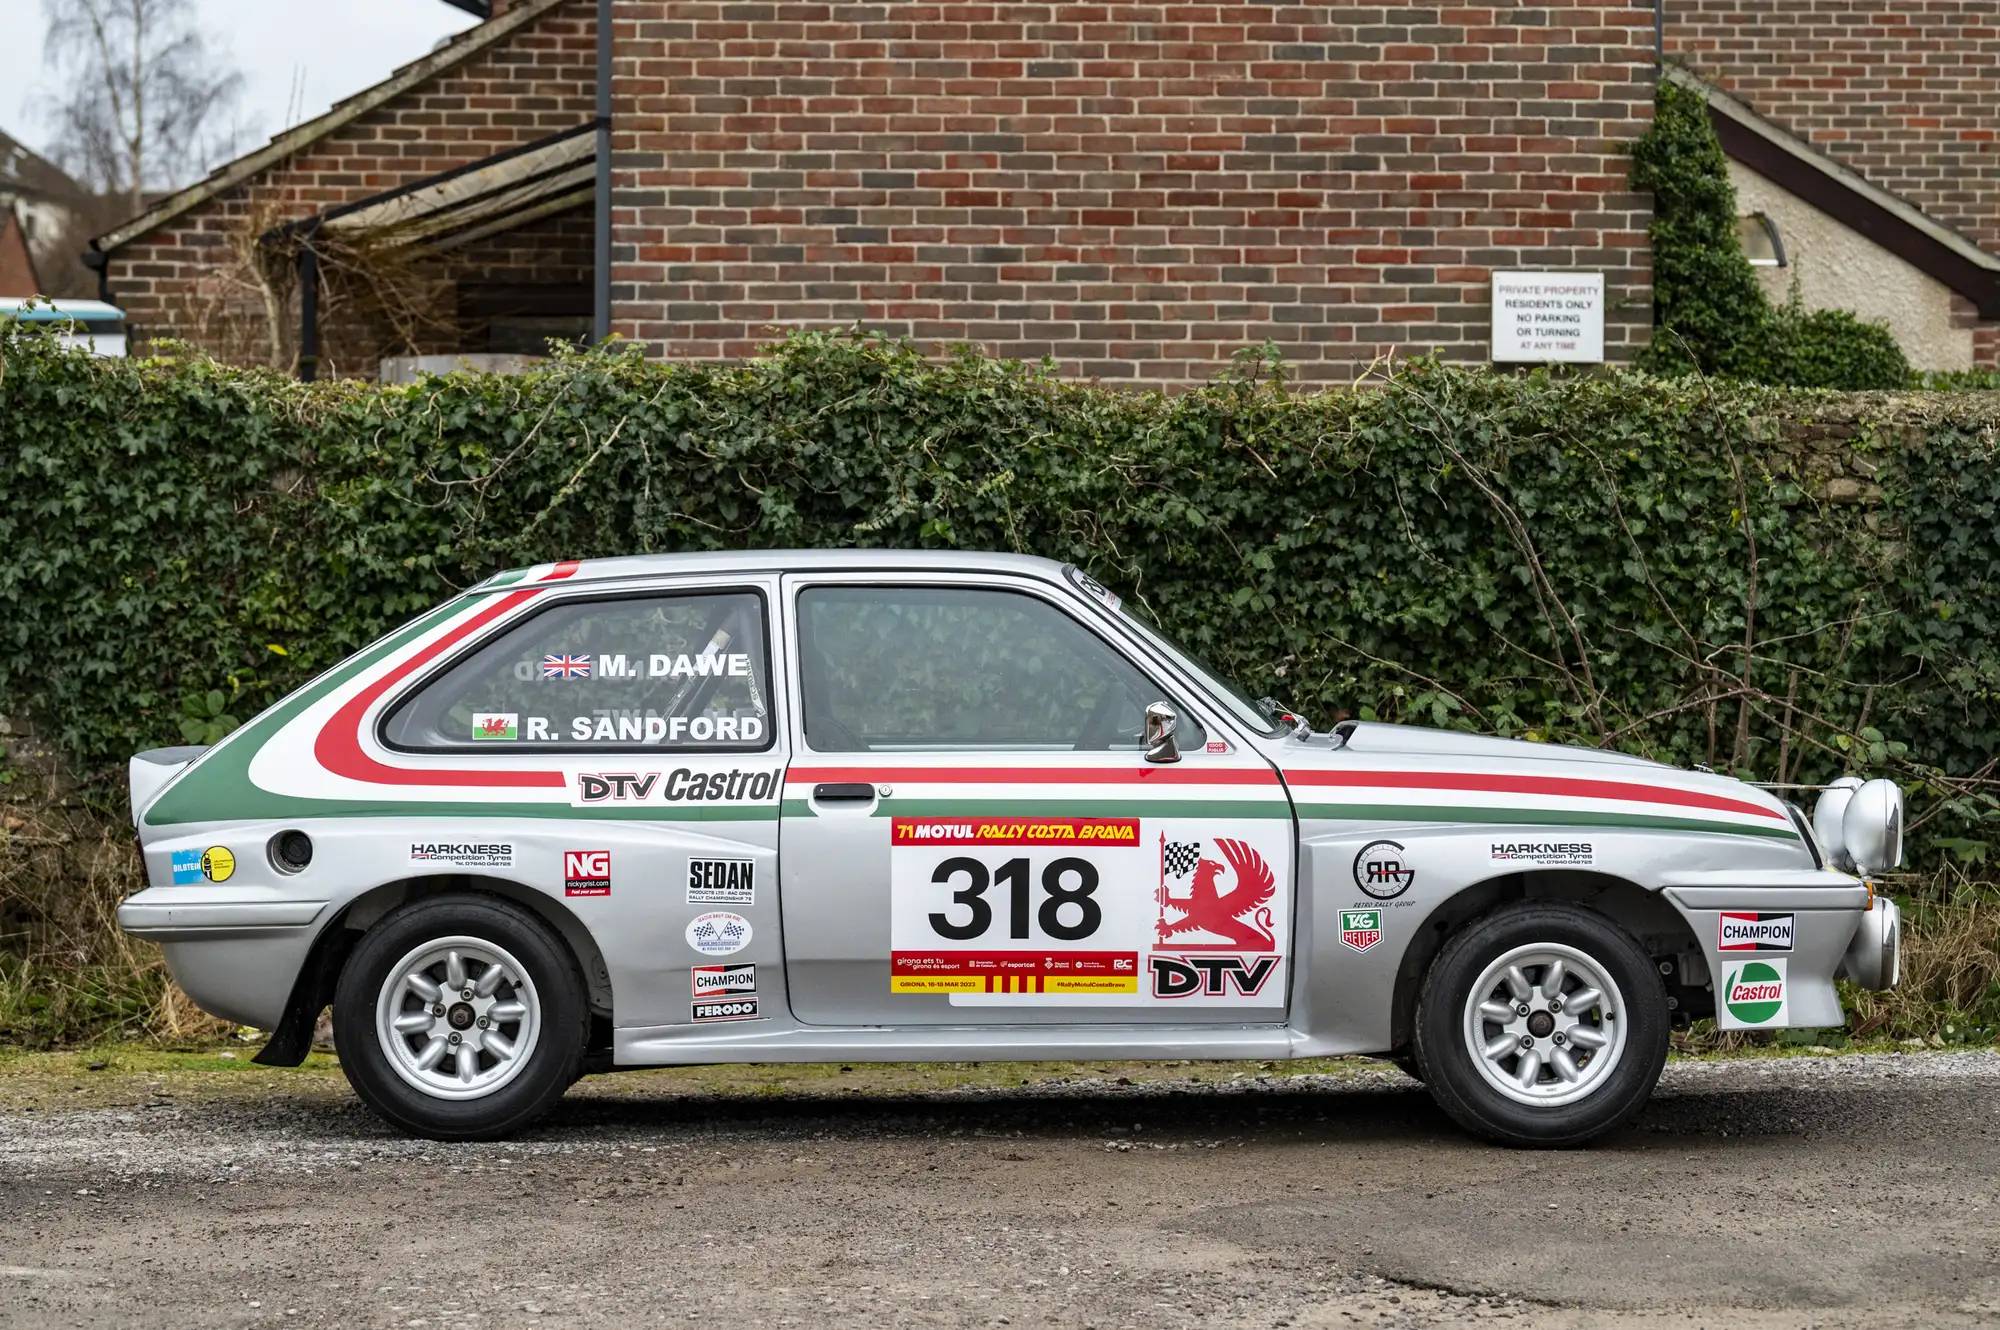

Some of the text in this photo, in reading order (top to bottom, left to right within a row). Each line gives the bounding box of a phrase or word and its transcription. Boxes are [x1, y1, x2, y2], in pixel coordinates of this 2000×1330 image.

[1499, 285, 1599, 295] PRIVATE PROPERTY
[1505, 299, 1593, 309] RESIDENTS ONLY
[1517, 314, 1580, 323] NO PARKING
[1517, 328, 1580, 337] OR TURNING
[1556, 342, 1576, 350] TIME
[599, 654, 636, 677] M.
[650, 654, 748, 677] DAWE
[527, 716, 763, 741] R. SANDFORD
[578, 767, 782, 802] DTV Castrol
[897, 824, 1135, 840] 71 MOTUL RALLY COSTA BRAVA
[411, 844, 512, 855] HARKNESS
[1491, 843, 1592, 853] HARKNESS
[567, 853, 609, 877] NG
[690, 861, 753, 890] SEDAN
[928, 856, 1102, 941] 318
[1347, 913, 1374, 929] TAG
[1344, 931, 1378, 948] HEUER
[1723, 925, 1791, 939] CHAMPION
[897, 957, 921, 967] girona
[696, 973, 753, 988] CHAMPION
[1148, 955, 1282, 999] DTV
[1732, 983, 1782, 1001] Castrol
[696, 1003, 753, 1017] FERODO
